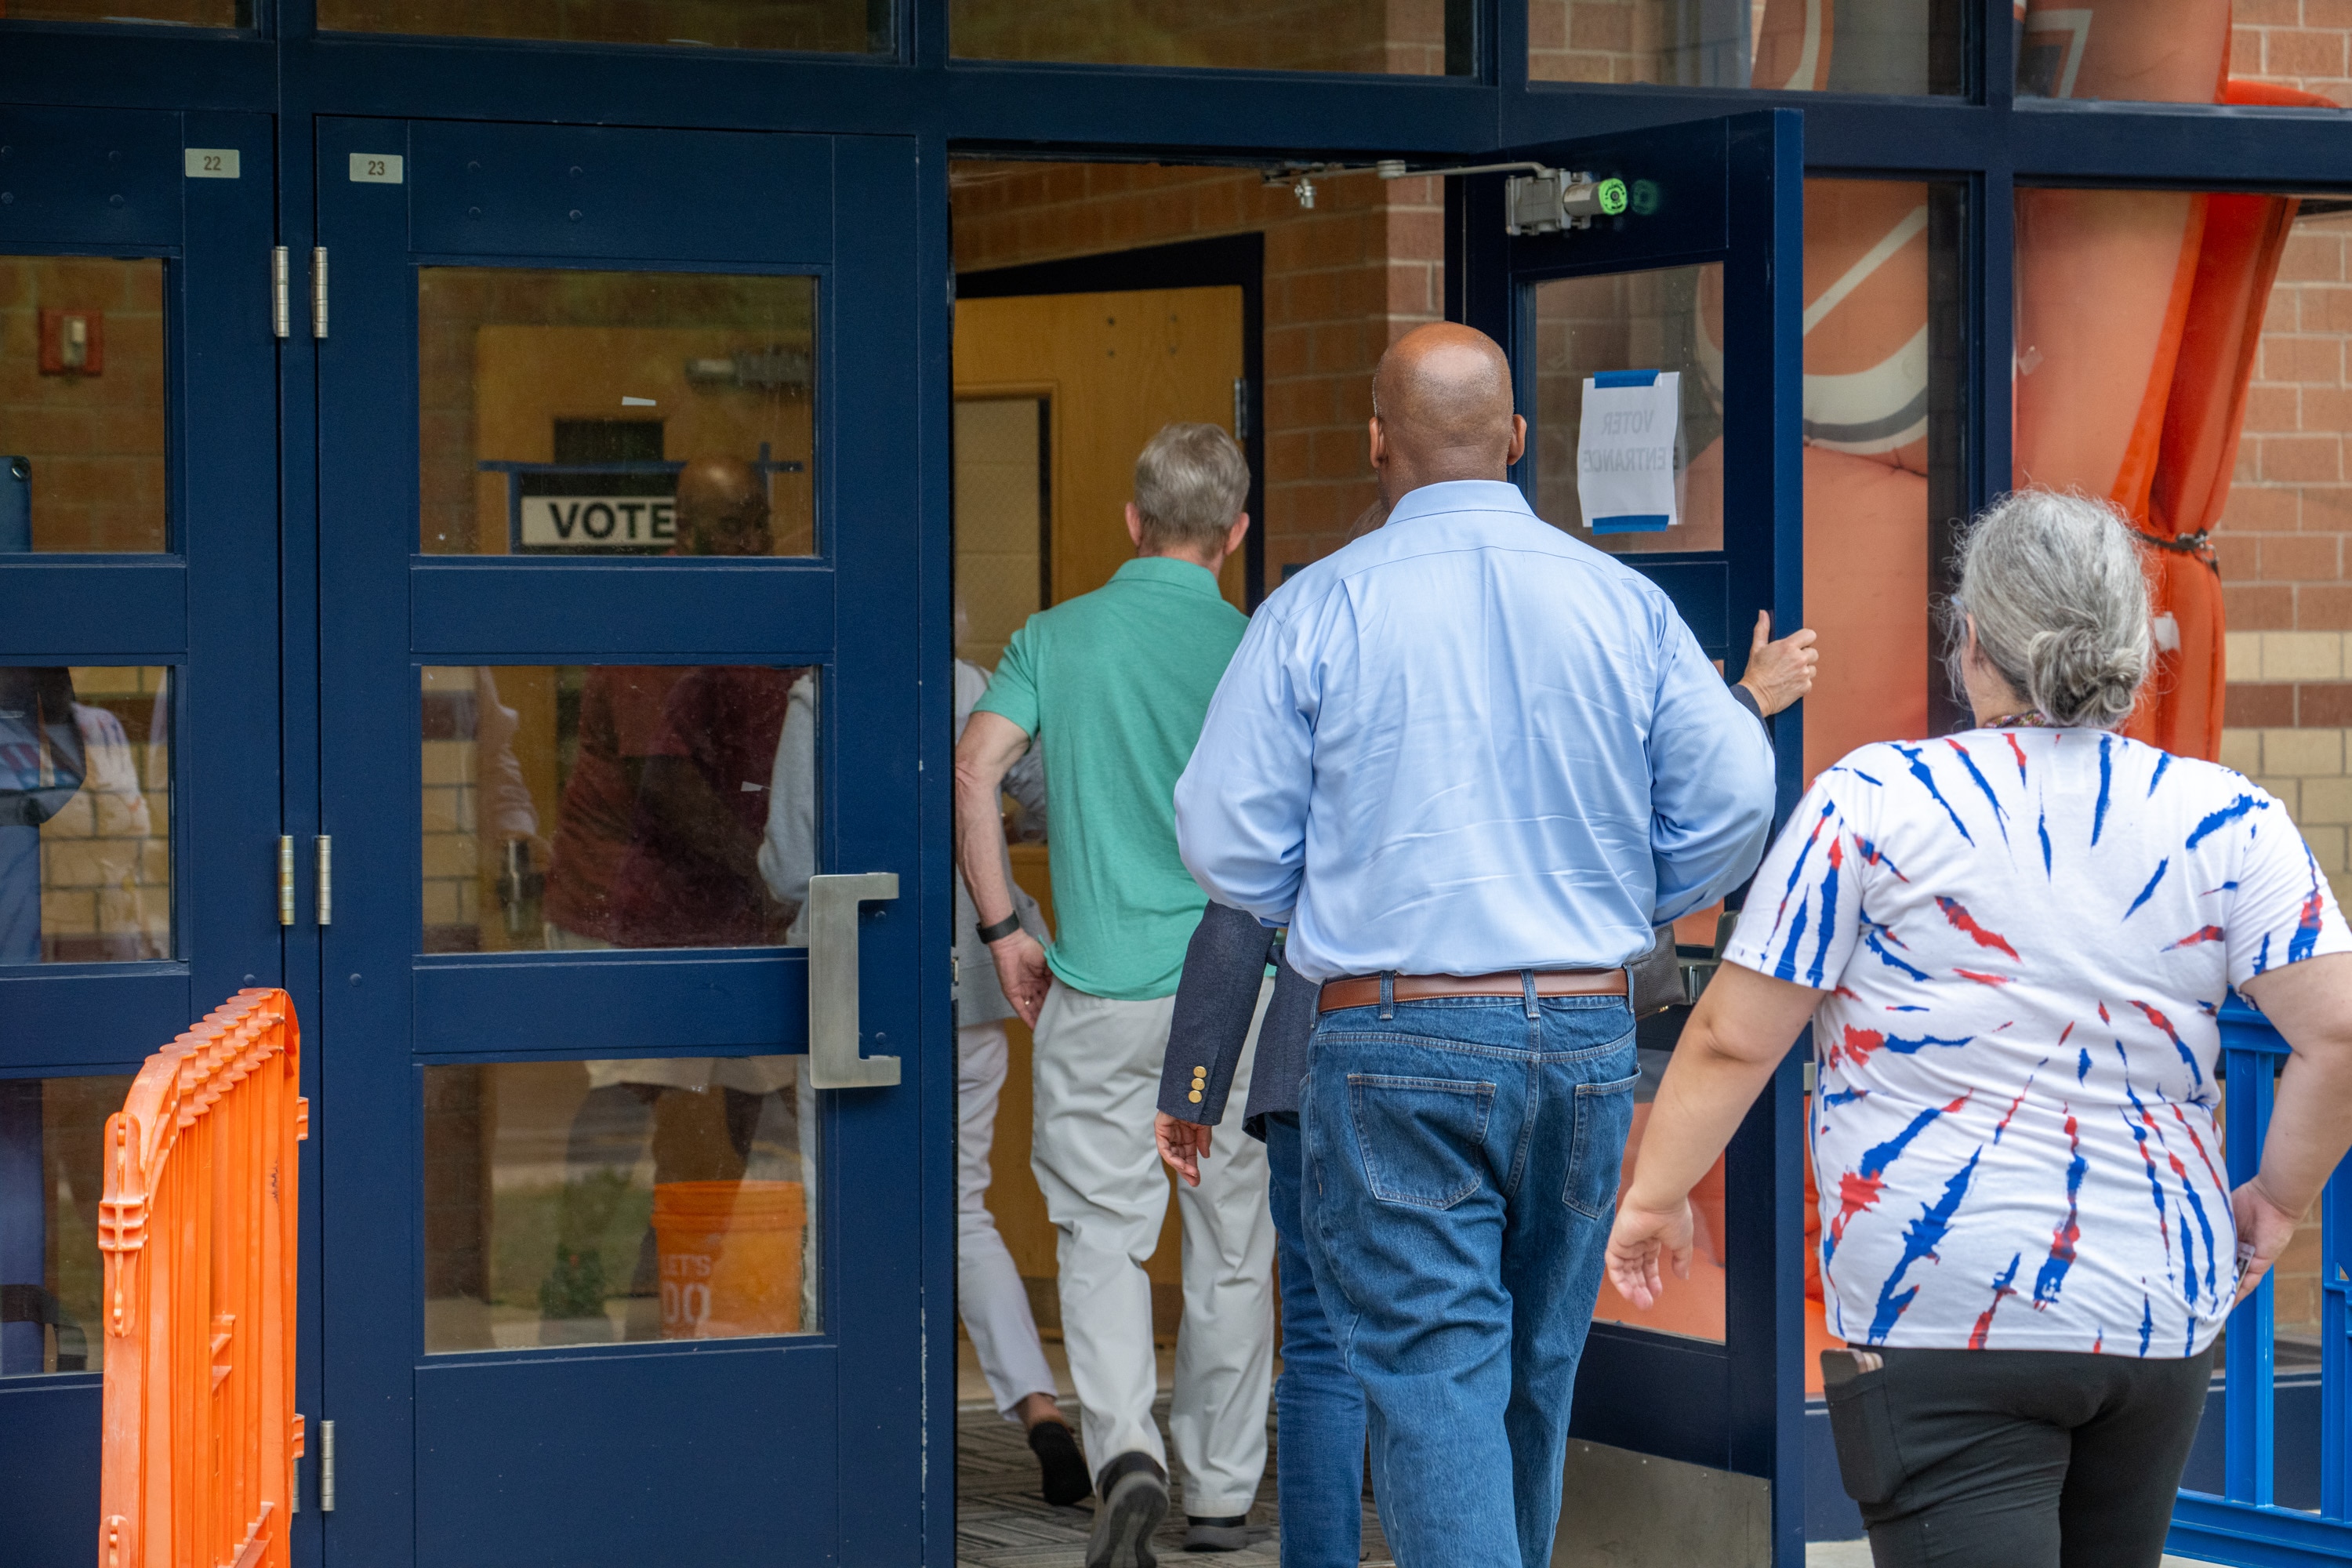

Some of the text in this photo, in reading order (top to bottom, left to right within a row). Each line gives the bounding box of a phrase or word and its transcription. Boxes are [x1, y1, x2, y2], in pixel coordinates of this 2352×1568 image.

[203, 156, 221, 171] 22
[368, 161, 385, 176] 23
[550, 503, 674, 539] VOTE
